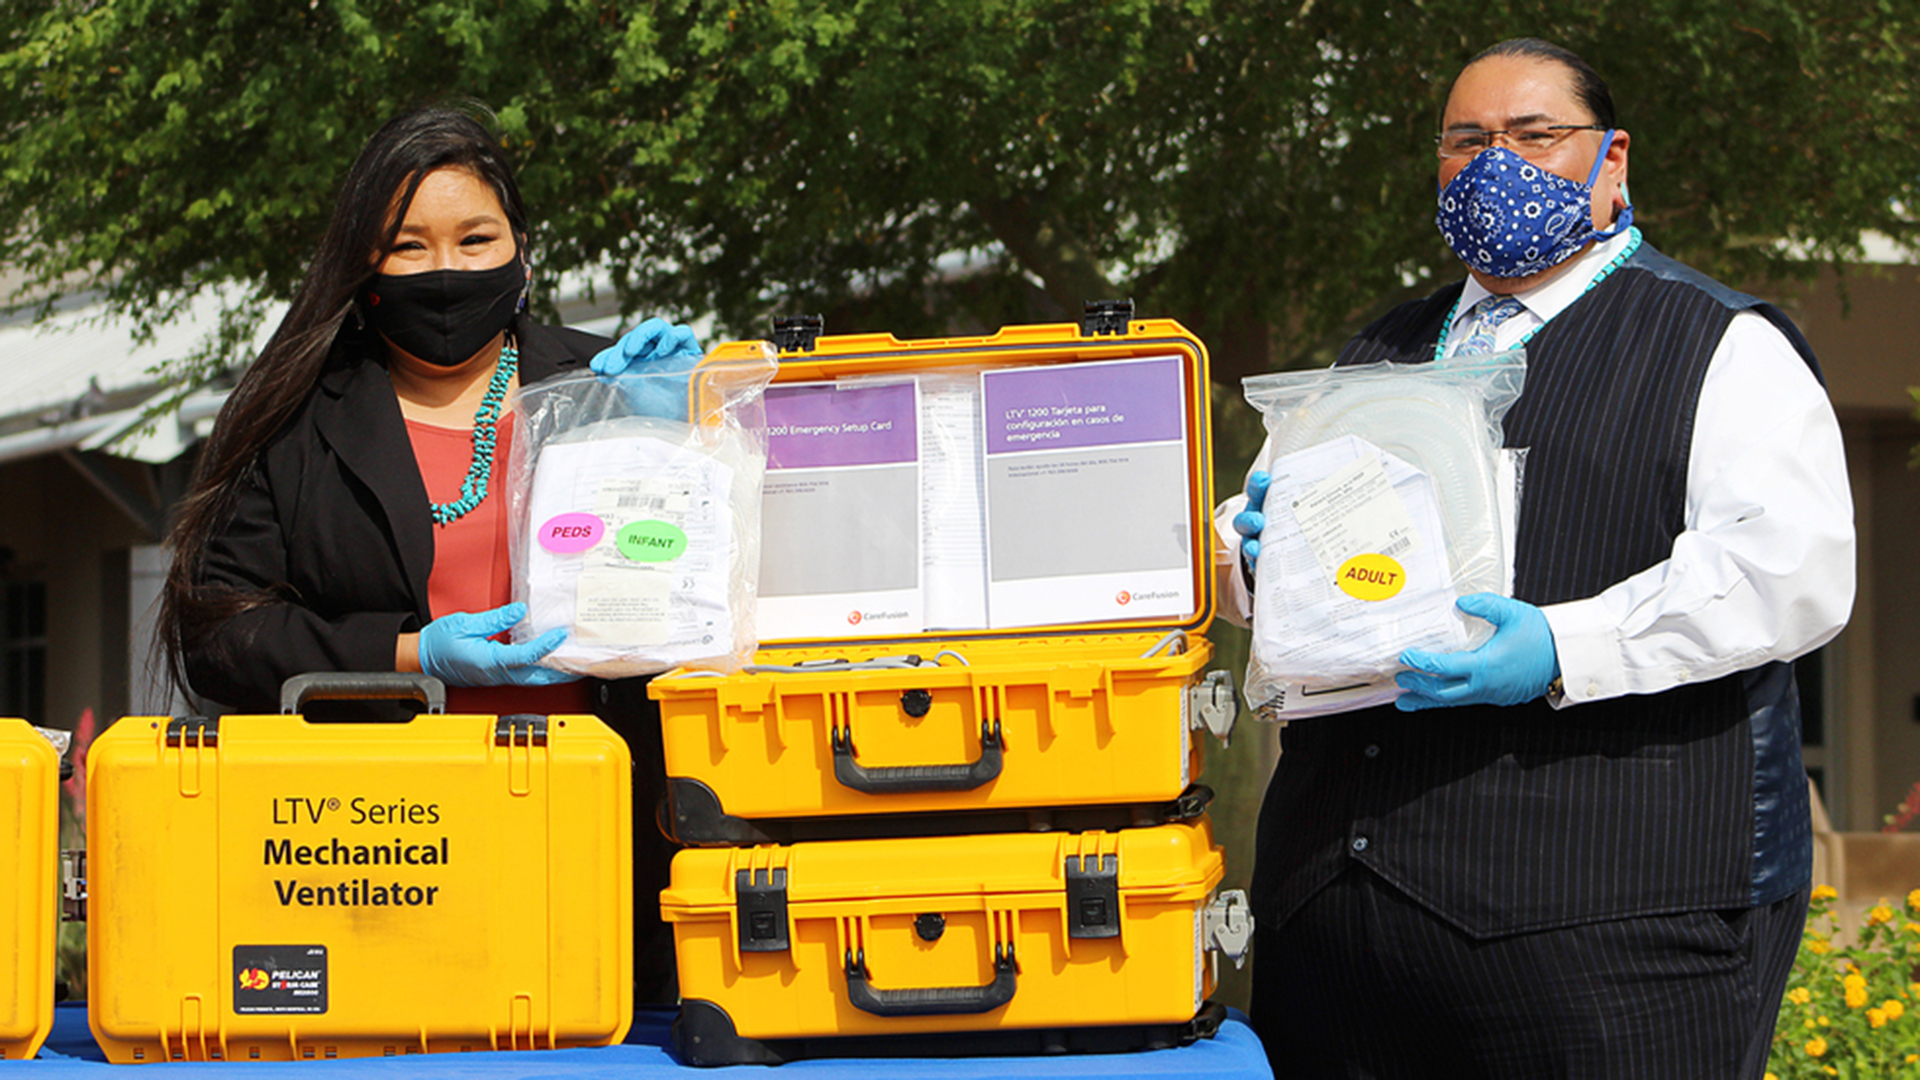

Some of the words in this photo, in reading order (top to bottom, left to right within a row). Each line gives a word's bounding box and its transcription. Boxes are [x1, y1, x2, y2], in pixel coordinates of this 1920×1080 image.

[1028, 407, 1049, 417] 1200
[1050, 405, 1083, 417] Tarjeta
[1085, 404, 1106, 415] para
[1071, 418, 1084, 426] en
[1085, 416, 1110, 425] casos
[1112, 414, 1124, 423] de
[766, 425, 788, 436] 1200
[789, 424, 840, 436] Emergency
[842, 422, 869, 434] Setup
[871, 421, 892, 431] Card
[1006, 430, 1061, 442] emergencia
[552, 526, 591, 538] PEDS
[628, 534, 674, 548] INFANT
[1345, 567, 1397, 586] ADULT
[1133, 589, 1180, 602] CareFusion
[863, 610, 909, 622] CareFusion
[350, 797, 440, 825] Series
[264, 837, 448, 866] Mechanical
[274, 879, 439, 906] Ventilator
